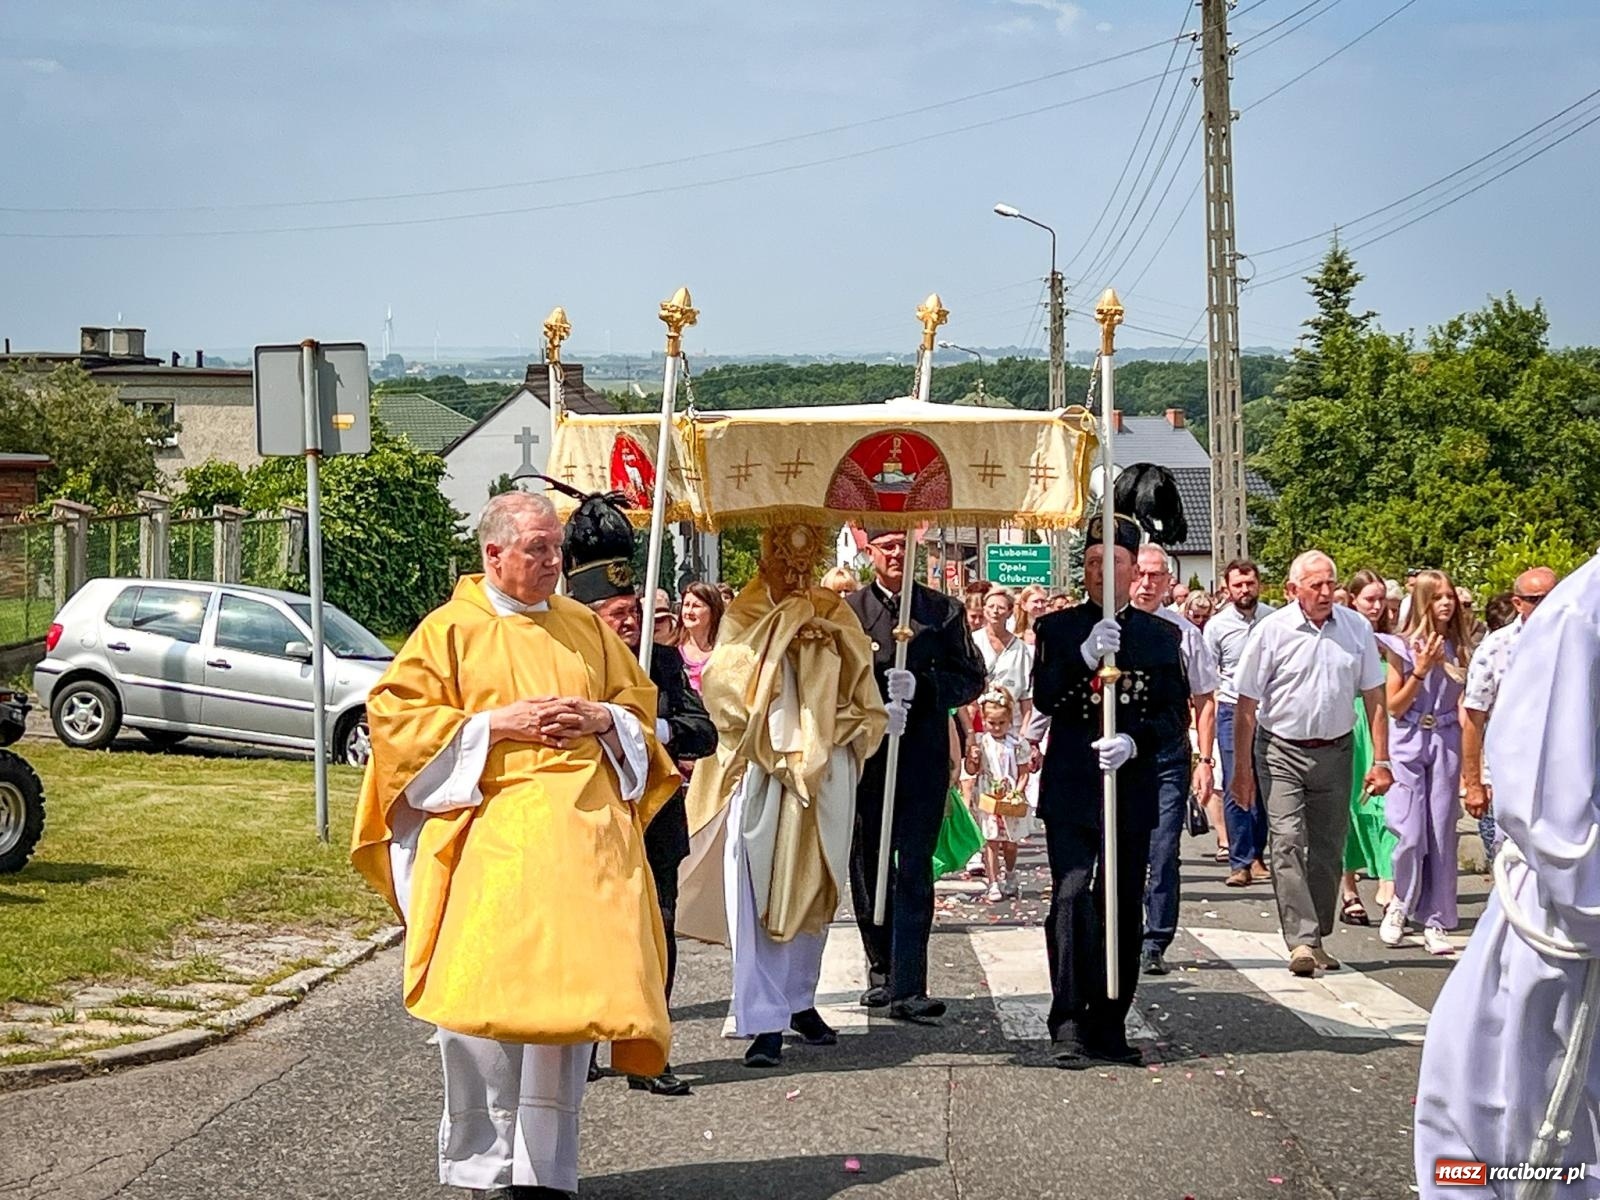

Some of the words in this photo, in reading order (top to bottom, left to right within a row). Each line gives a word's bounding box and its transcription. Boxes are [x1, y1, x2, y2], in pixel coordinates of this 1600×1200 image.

[999, 548, 1038, 557] Lubomia
[998, 563, 1027, 573] Opole
[998, 574, 1046, 583] Głubczyce
